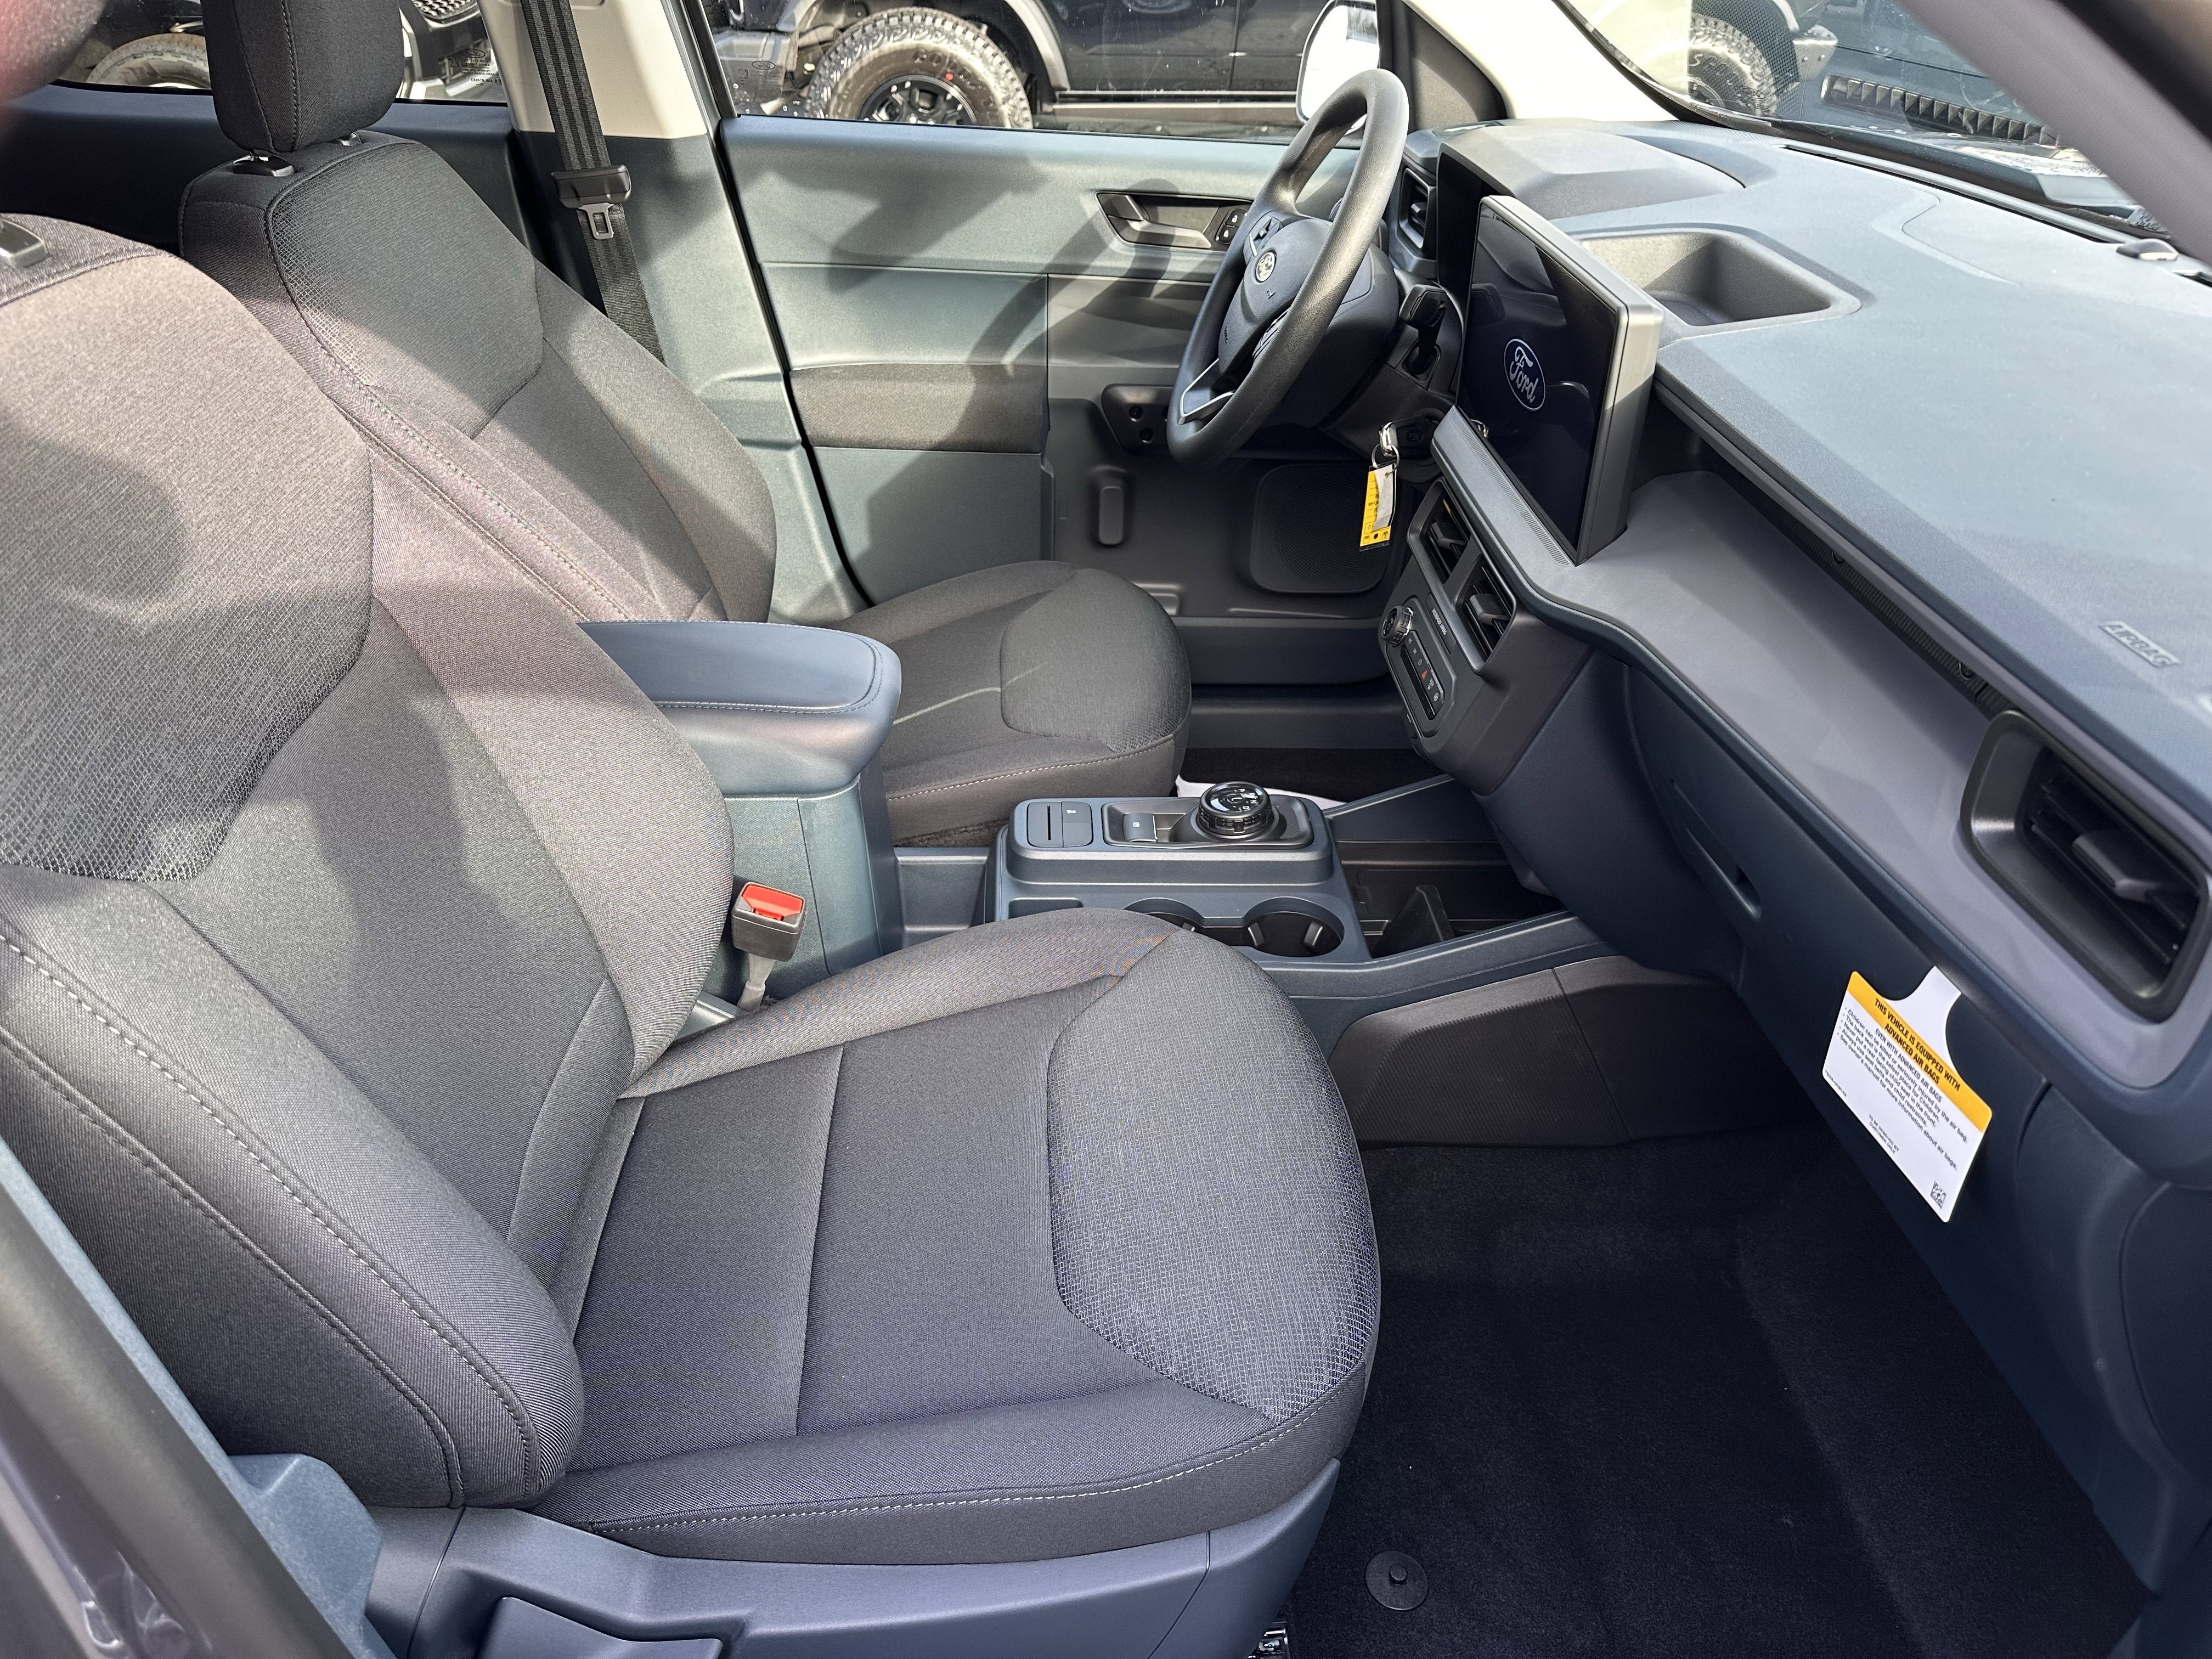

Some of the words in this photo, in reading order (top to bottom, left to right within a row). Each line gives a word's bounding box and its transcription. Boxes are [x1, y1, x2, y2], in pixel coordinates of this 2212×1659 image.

[1509, 346, 1539, 403] Ford
[1842, 1028, 1856, 1047] Always
[1865, 1054, 1874, 1066] seat
[1874, 1064, 1884, 1078] belts
[1884, 1077, 1893, 1088] and
[1893, 1087, 1905, 1101] child
[1843, 1021, 1855, 1037] Never
[1866, 1048, 1875, 1059] rear
[1875, 1057, 1889, 1075] facing
[1889, 1073, 1900, 1087] child
[1900, 1085, 1910, 1098] seat
[1848, 1009, 1865, 1031] Children
[1865, 1029, 1873, 1039] can
[1880, 1043, 1892, 1059] killed
[1897, 1063, 1917, 1088] seriously
[1917, 1085, 1934, 1105] injured
[1941, 1110, 1949, 1122] the
[1854, 1024, 1864, 1038] back
[1864, 1036, 1874, 1048] seat
[1886, 1060, 1899, 1076] safest
[1899, 1075, 1911, 1090] place
[1875, 997, 1887, 1015] THIS
[1887, 1011, 1909, 1039] VEHICLE
[1908, 1034, 1915, 1045] IS
[1915, 1041, 1943, 1074] EQUIPPED
[1944, 1069, 1960, 1091] WITH
[1875, 1028, 1886, 1043] EVEN
[1886, 1040, 1898, 1056] WITH
[1897, 1053, 1920, 1080] ADVANCED
[1920, 1077, 1929, 1089] AIR
[1929, 1086, 1942, 1103] BAGS
[1884, 1023, 1913, 1056] ADVANCED
[1912, 1053, 1923, 1068] AIR
[1923, 1063, 1939, 1084] BAGS
[1864, 1062, 1880, 1081] manual
[1886, 1087, 1898, 1102] more
[1898, 1099, 1923, 1131] information
[1923, 1130, 1937, 1147] about
